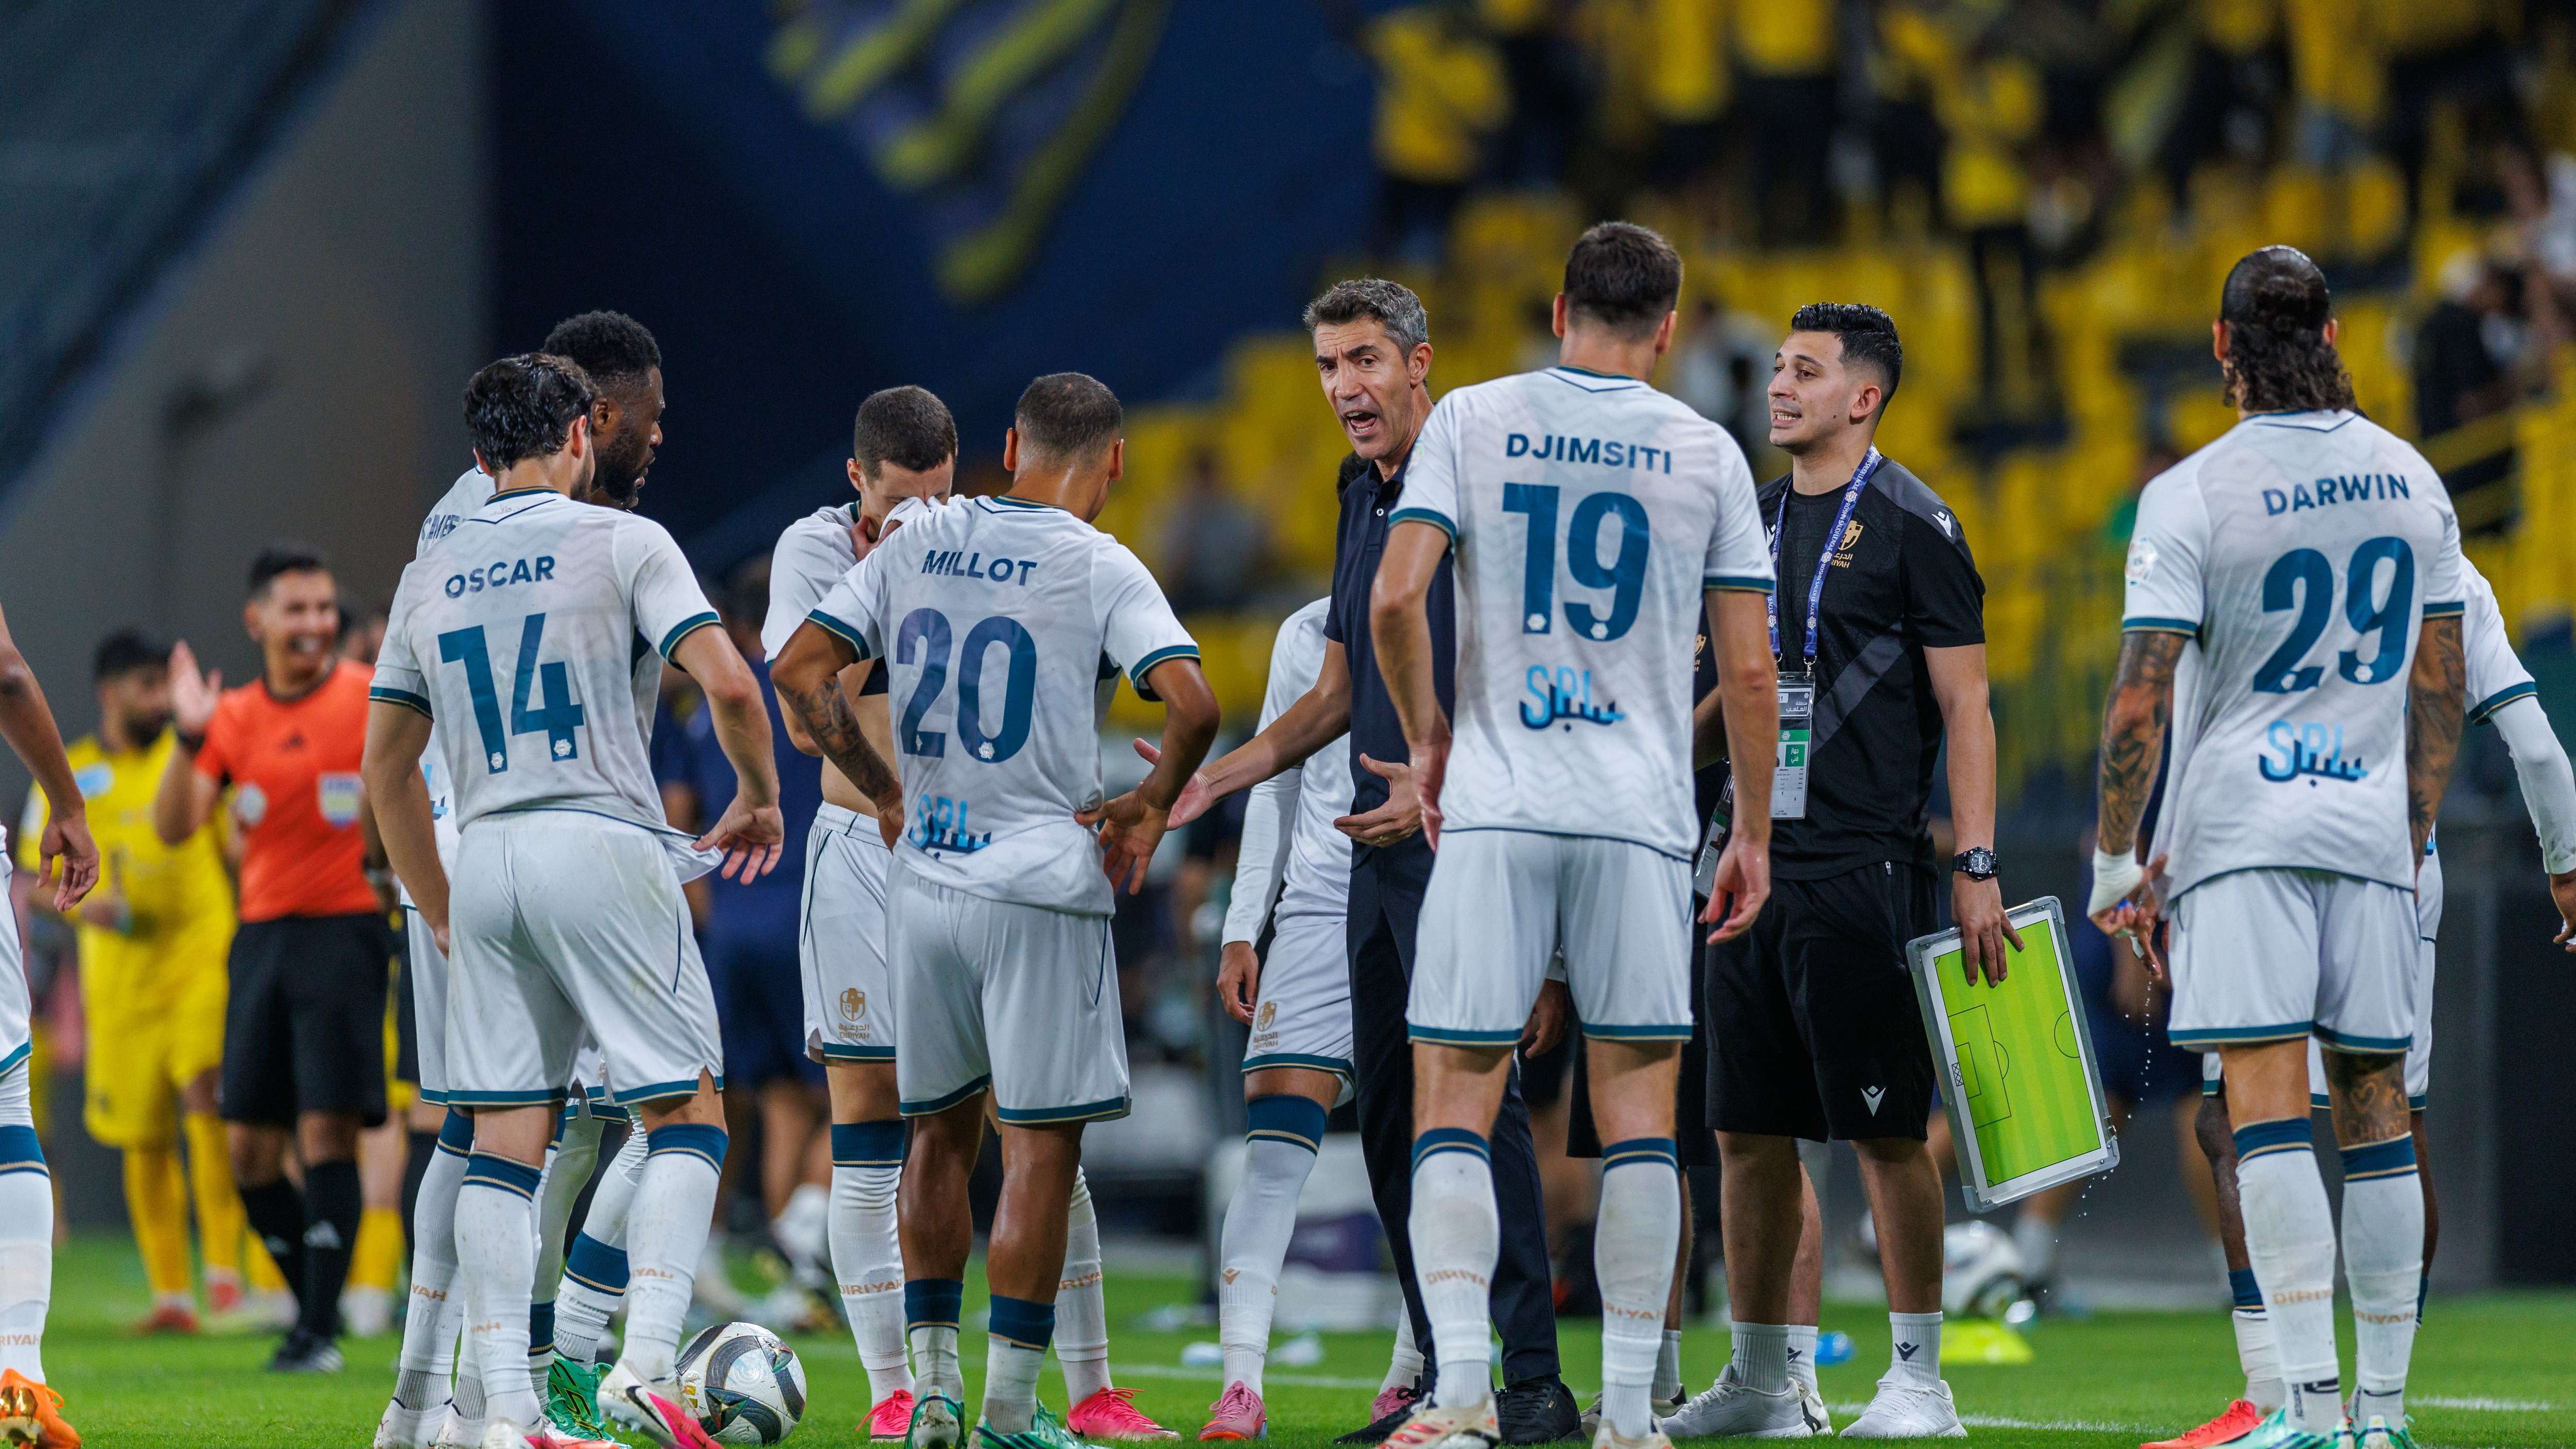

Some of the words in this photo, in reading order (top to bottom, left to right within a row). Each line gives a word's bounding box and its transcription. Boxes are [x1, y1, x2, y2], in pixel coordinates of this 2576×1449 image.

[1506, 433, 1671, 474] DJIMSITI
[1852, 474, 1864, 490] LEAGUE
[2261, 474, 2410, 516] DARWIN
[1834, 520, 1844, 535] SAUDI
[1840, 503, 1850, 520] ROSHN
[1502, 482, 1649, 641] 19
[1827, 534, 1838, 551] LEAGUE
[445, 556, 555, 599] OSCAR
[921, 550, 1037, 587] MILLOT
[1817, 564, 1825, 581] ROSHN
[1832, 560, 1850, 568] RIYAH
[2253, 536, 2414, 694] 29
[438, 612, 584, 775] 14
[896, 608, 1037, 764] 20
[1526, 665, 1626, 725] SPL
[2267, 720, 2369, 778] SPL
